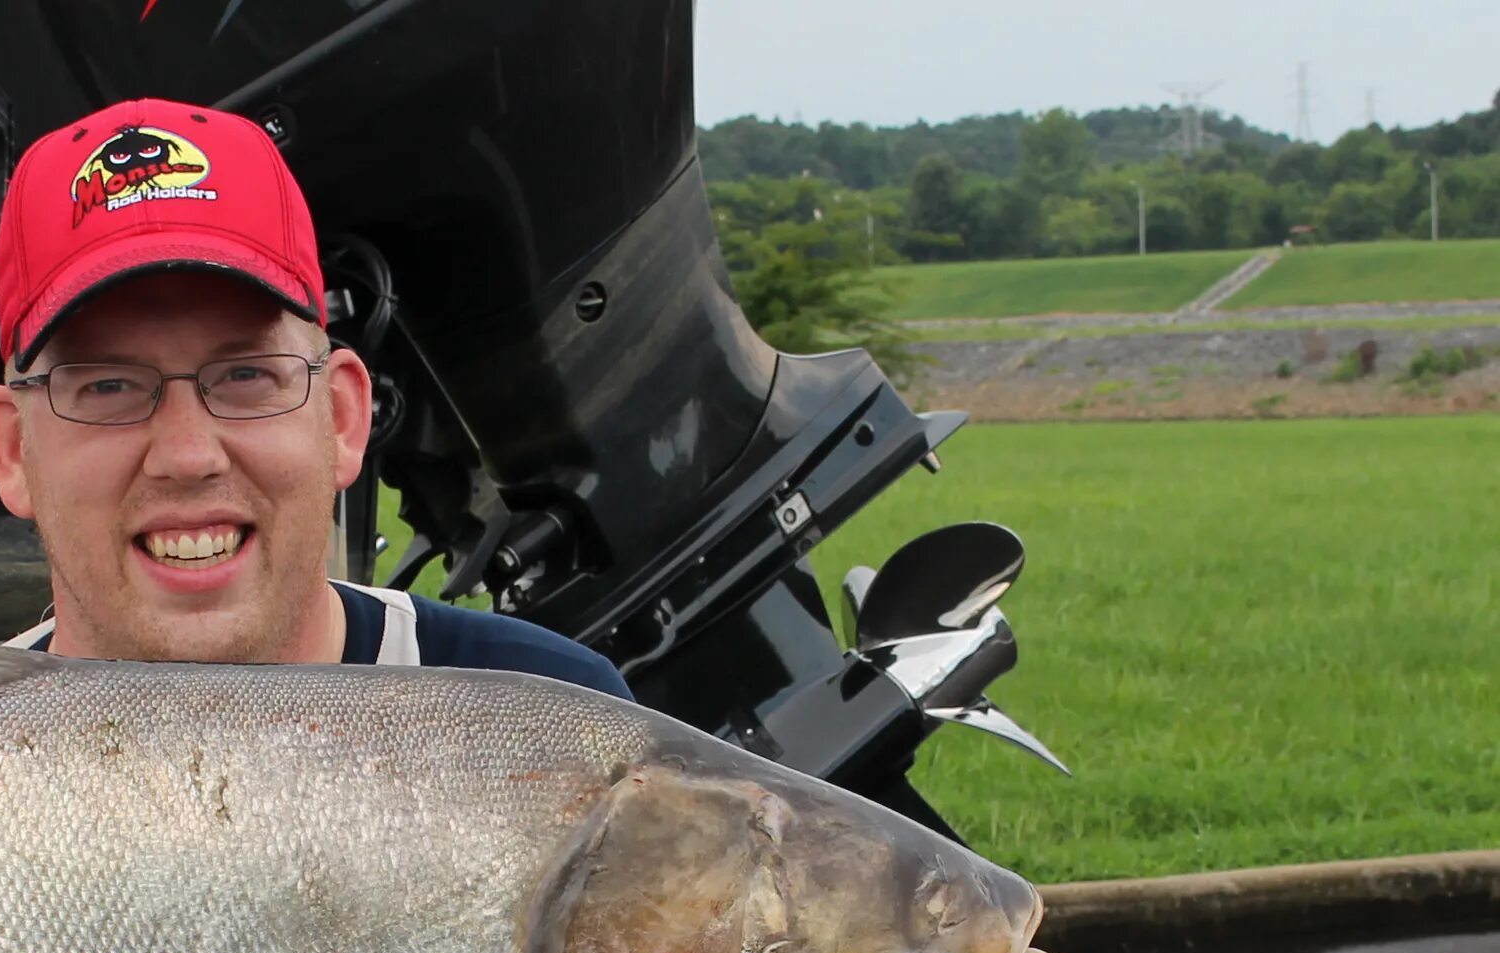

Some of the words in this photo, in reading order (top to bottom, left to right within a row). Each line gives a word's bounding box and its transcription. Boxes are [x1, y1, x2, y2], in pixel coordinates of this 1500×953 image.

[73, 163, 204, 229] Monster
[106, 190, 142, 211] Rod
[147, 186, 217, 200] Holders
